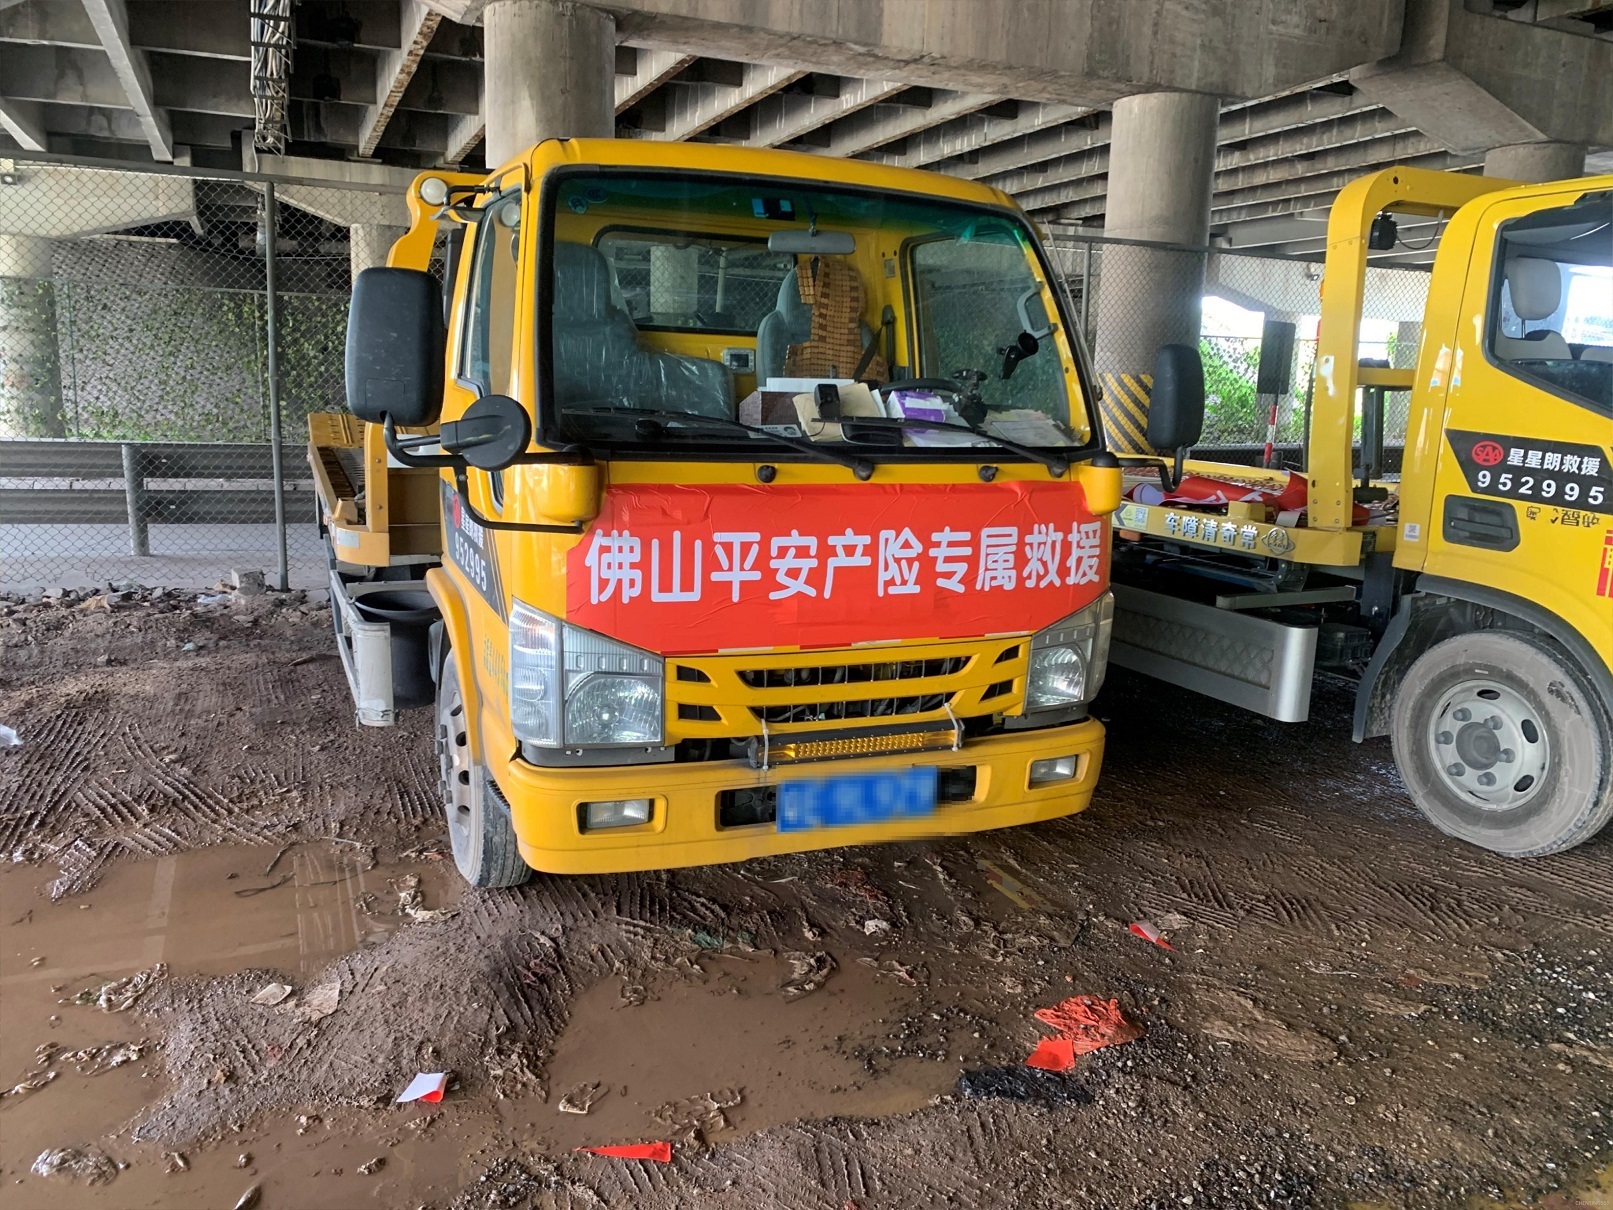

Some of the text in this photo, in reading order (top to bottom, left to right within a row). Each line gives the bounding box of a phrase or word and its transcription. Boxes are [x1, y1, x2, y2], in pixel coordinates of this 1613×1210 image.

[1506, 448, 1601, 477] 星星朗救援
[1477, 470, 1605, 505] 952995
[454, 531, 487, 592] 952995
[584, 520, 1101, 605] 佛山平安产险专属救援
